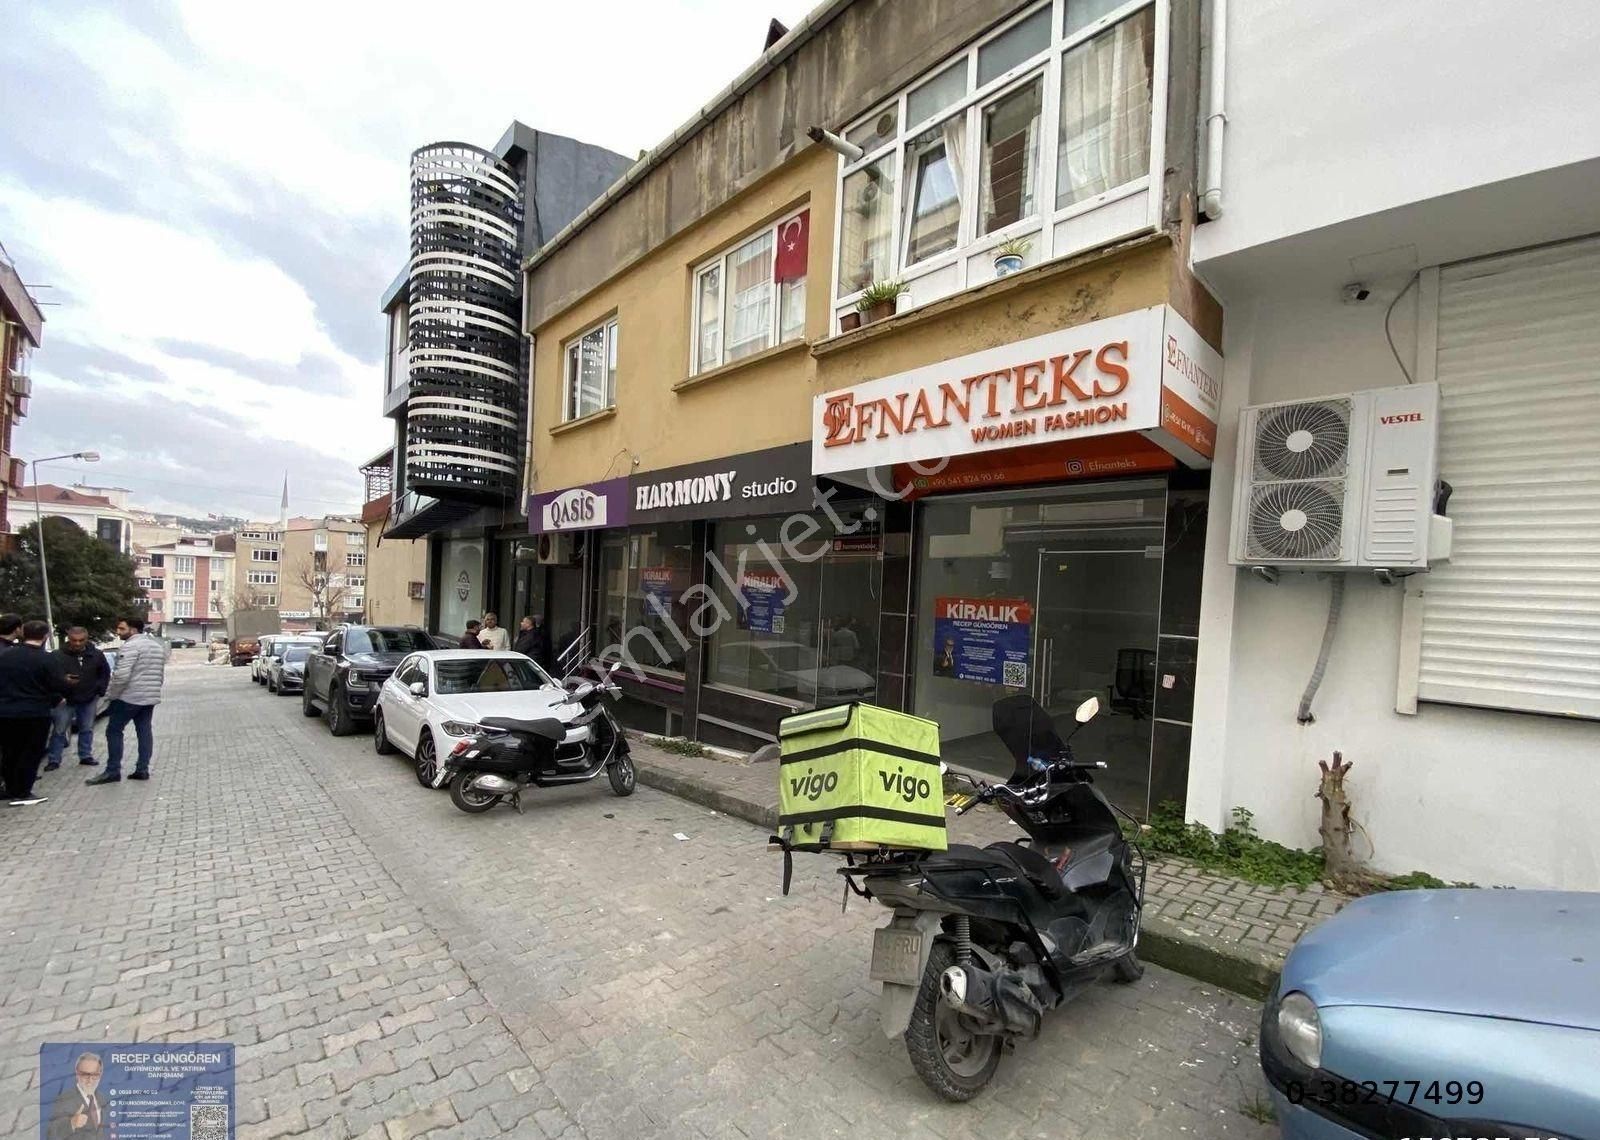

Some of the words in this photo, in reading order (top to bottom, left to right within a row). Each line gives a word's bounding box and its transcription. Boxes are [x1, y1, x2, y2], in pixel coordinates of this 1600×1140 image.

[971, 418, 1037, 443] WOMEN
[1044, 402, 1128, 432] FASHION
[1380, 412, 1424, 425] VESTEL
[635, 470, 737, 511] HARMONY
[741, 476, 798, 498] studio
[946, 600, 1020, 623] KİRALIK
[790, 767, 838, 801] vigo
[879, 766, 930, 802] vigo
